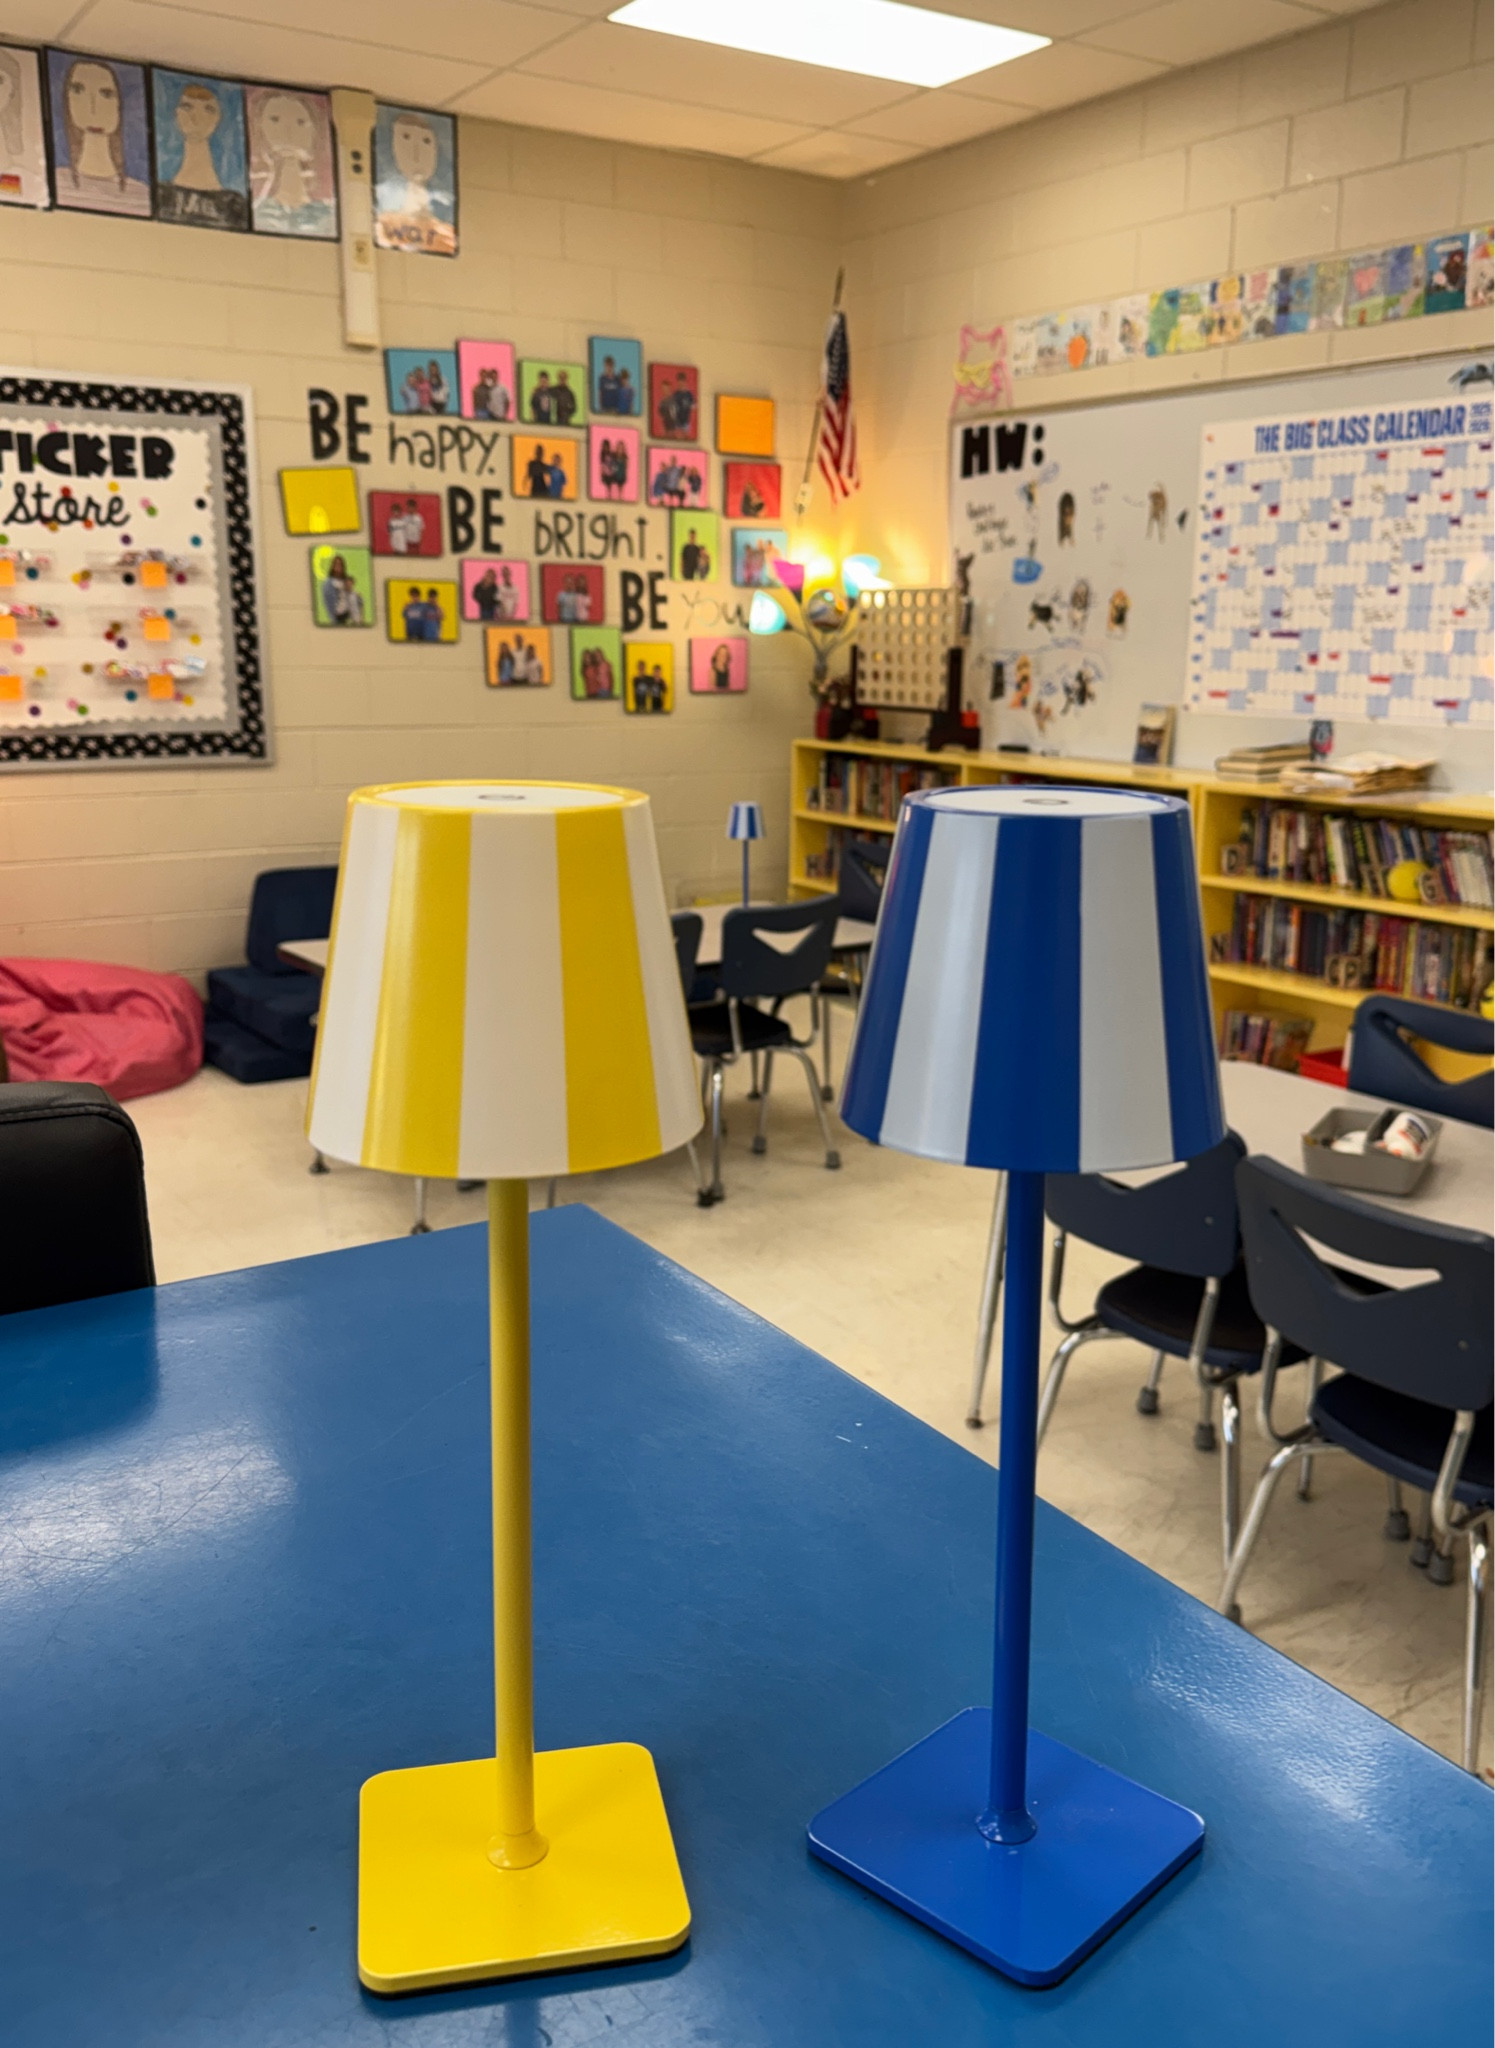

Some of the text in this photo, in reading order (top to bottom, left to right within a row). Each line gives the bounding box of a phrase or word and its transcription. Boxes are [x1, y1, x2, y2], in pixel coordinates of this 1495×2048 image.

[308, 387, 371, 464] BE
[961, 422, 1045, 478] HW:
[1255, 405, 1466, 453] THE BIG CLASS CALENDAR
[3, 482, 131, 527] store
[447, 485, 503, 554] BE
[620, 570, 667, 632] BE
